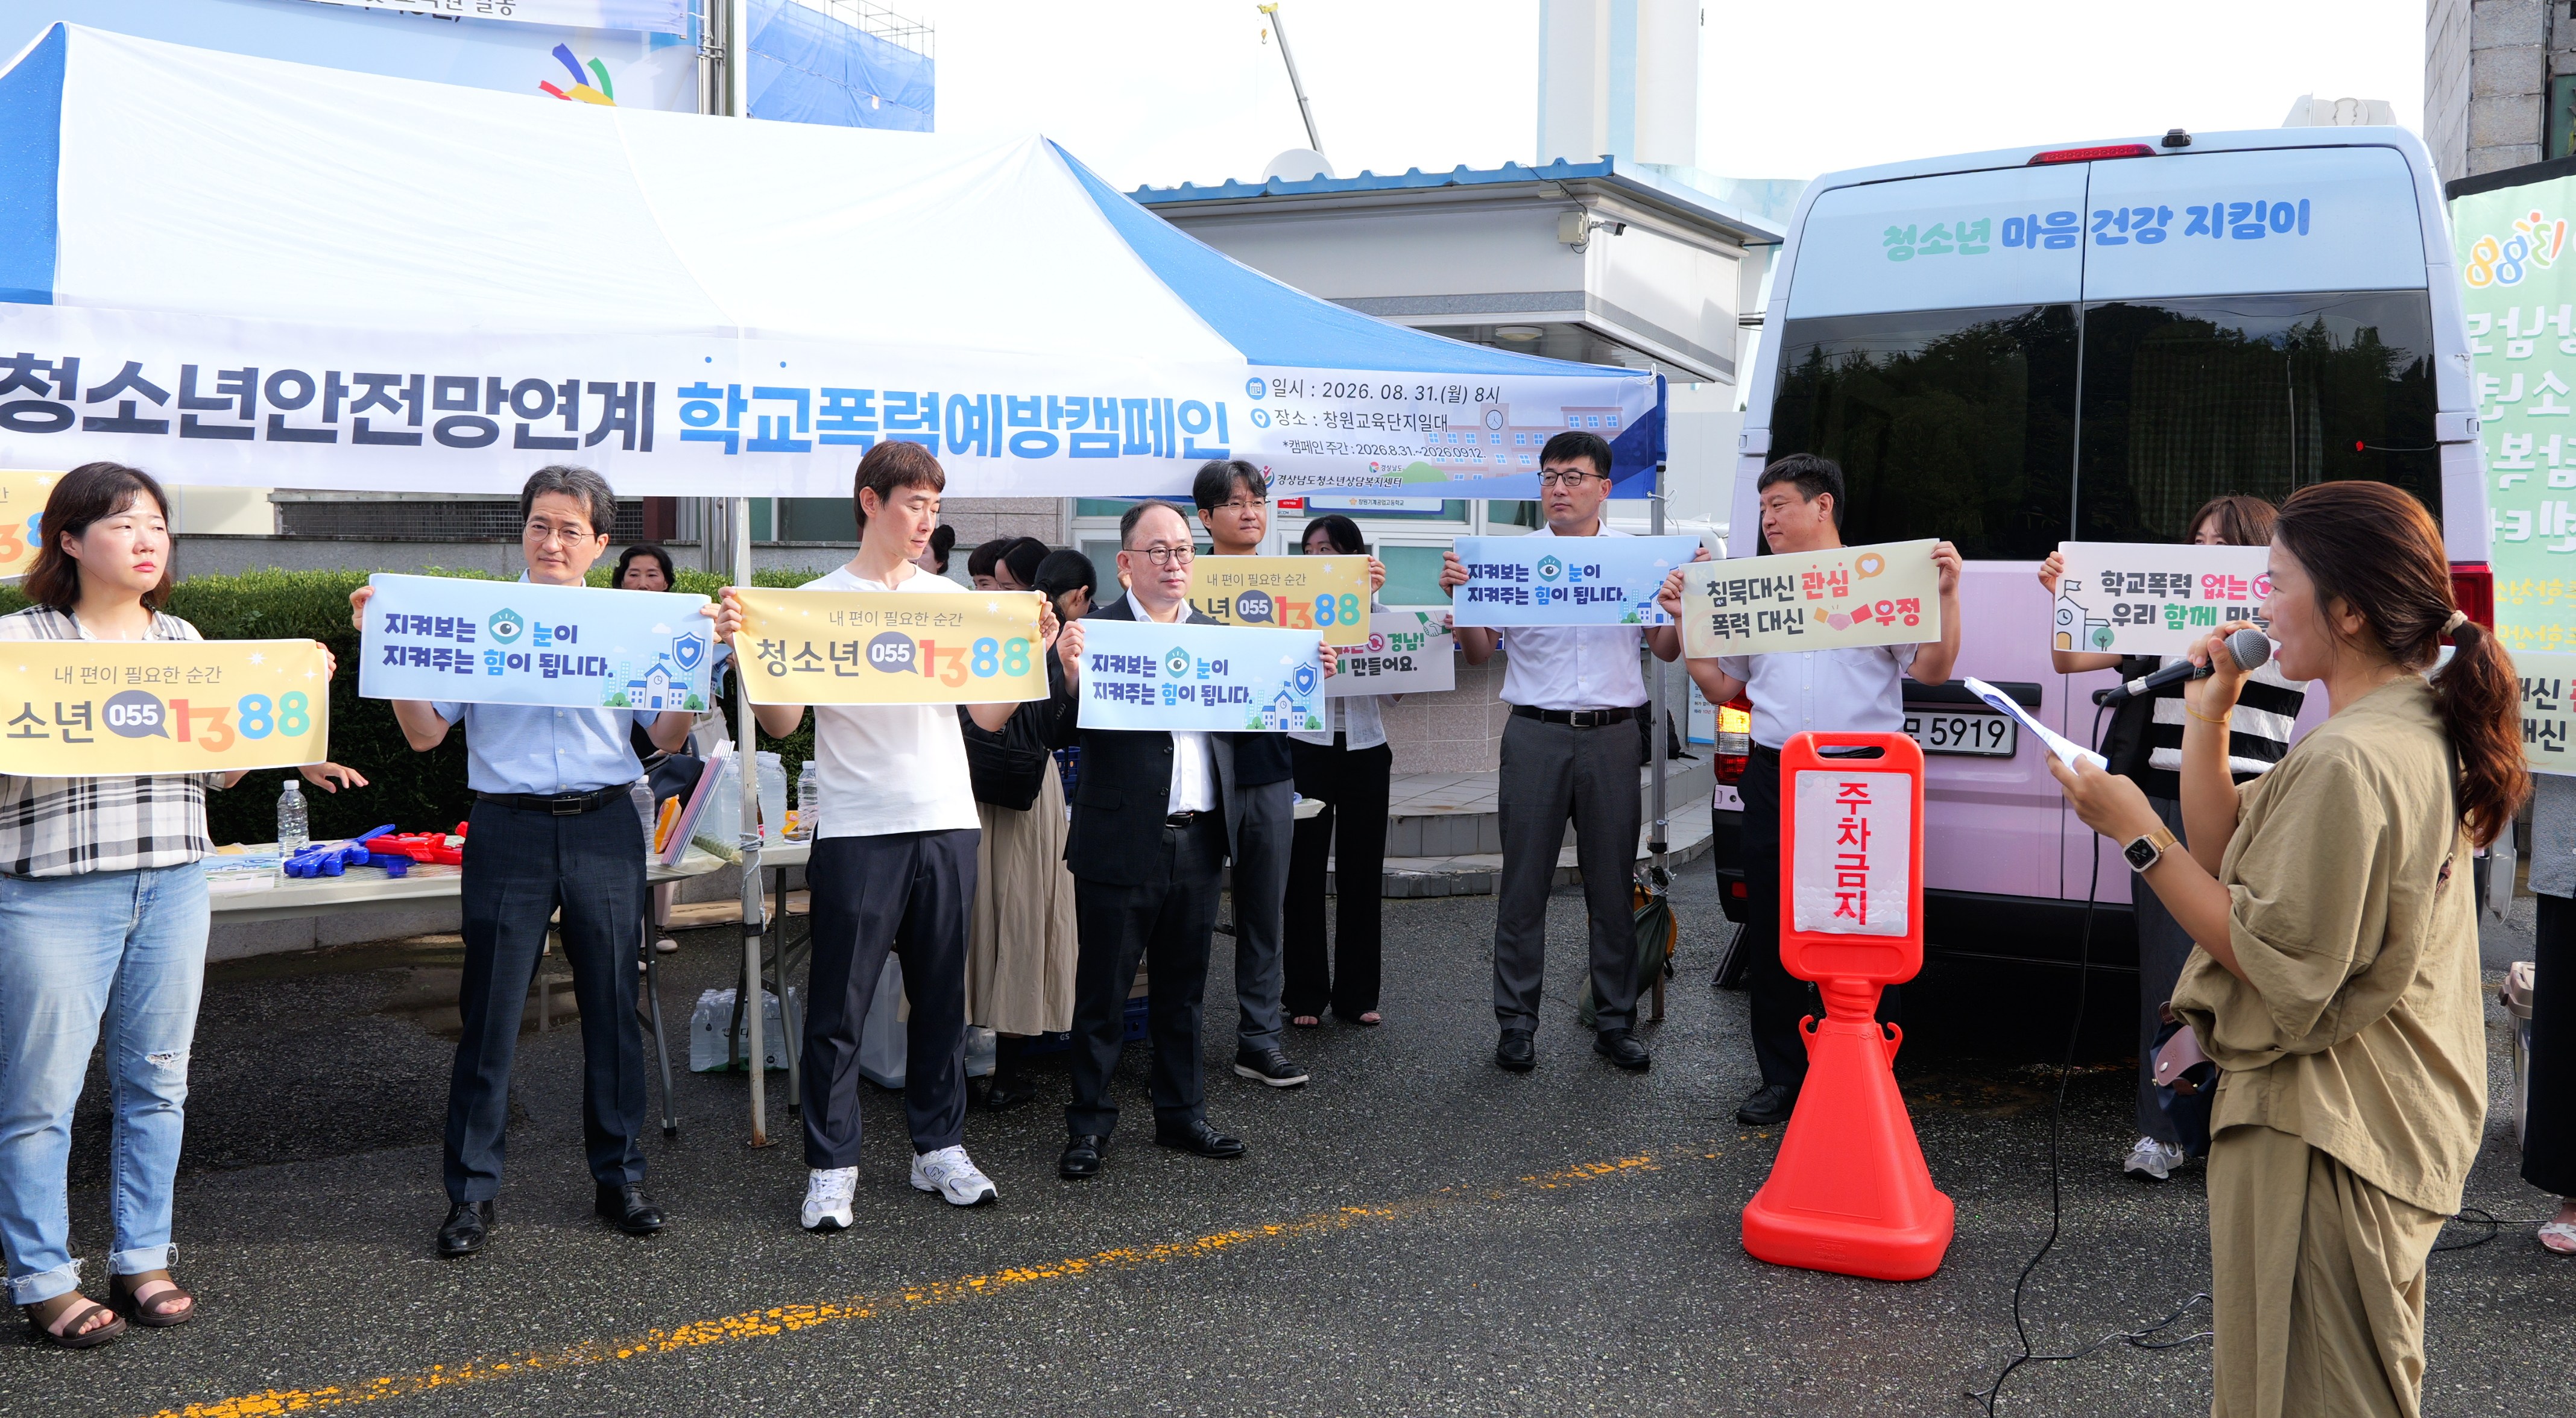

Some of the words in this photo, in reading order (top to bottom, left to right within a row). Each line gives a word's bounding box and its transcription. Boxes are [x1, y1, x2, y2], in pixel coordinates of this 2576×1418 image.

[1883, 217, 1991, 262] 청소년
[2001, 210, 2080, 250] 마음
[2090, 205, 2174, 245] 건강
[2184, 198, 2310, 240] 지킴이
[1272, 378, 1304, 399] 일시
[1322, 382, 1374, 400] 2026.
[1380, 384, 1408, 402] 08.
[1474, 386, 1501, 405] 8시
[0, 352, 655, 452] 청소년안전망연계
[677, 381, 1231, 459] 학교폭력예방캠페인
[1275, 409, 1309, 427] 장소
[1323, 411, 1448, 433] 창원교육단지일대
[1326, 441, 1350, 455] 주간
[1277, 474, 1403, 488] 경상남도청소년상담복지센터
[1207, 574, 1218, 586] 내
[1222, 573, 1244, 587] 편이
[1248, 573, 1281, 587] 필요한
[1284, 573, 1307, 586] 순간
[1468, 562, 1529, 583] 지켜보는
[1568, 562, 1600, 583] 눈이
[2101, 570, 2192, 599] 학교폭력
[2201, 573, 2248, 601] 없는
[1468, 585, 1529, 605] 지켜주는
[1534, 585, 1568, 605] 힘이
[1573, 585, 1627, 605] 됩니다.
[1706, 573, 1795, 608] 침묵대신
[1801, 569, 1850, 601] 관심
[829, 611, 844, 626] 내
[848, 611, 878, 627] 편이
[883, 611, 929, 627] 필요한
[933, 611, 964, 628] 순간
[1239, 599, 1269, 615] 055
[1275, 593, 1360, 630] 1388
[1711, 608, 1750, 640] 폭력
[1758, 608, 1804, 635] 대신
[1874, 597, 1921, 626] 우정
[2112, 603, 2156, 627] 우리
[2164, 603, 2217, 630] 함께
[384, 613, 476, 643] 지켜보는
[533, 622, 578, 648] 눈이
[1387, 632, 1424, 652] 경남!
[383, 644, 475, 675] 지켜주는
[484, 648, 531, 676] 힘이
[538, 653, 614, 679] 됩니다.
[757, 638, 860, 678] 청소년
[871, 643, 910, 663] 055
[919, 637, 1031, 688] 1388
[1090, 653, 1157, 678] 지켜보는
[1196, 657, 1228, 680] 눈이
[1351, 655, 1418, 676] 만들어요.
[54, 666, 73, 684] 내
[80, 666, 117, 685] 편이
[124, 666, 180, 685] 필요한
[186, 666, 222, 684] 순간
[1093, 681, 1155, 705] 지켜주는
[1161, 682, 1196, 706] 힘이
[1201, 684, 1252, 707] 됩니다.
[7, 701, 94, 743] 소년
[109, 704, 159, 726] 055
[169, 690, 311, 752] 1388
[1930, 717, 2006, 748] 5919
[1833, 783, 1872, 925] 주차금지
